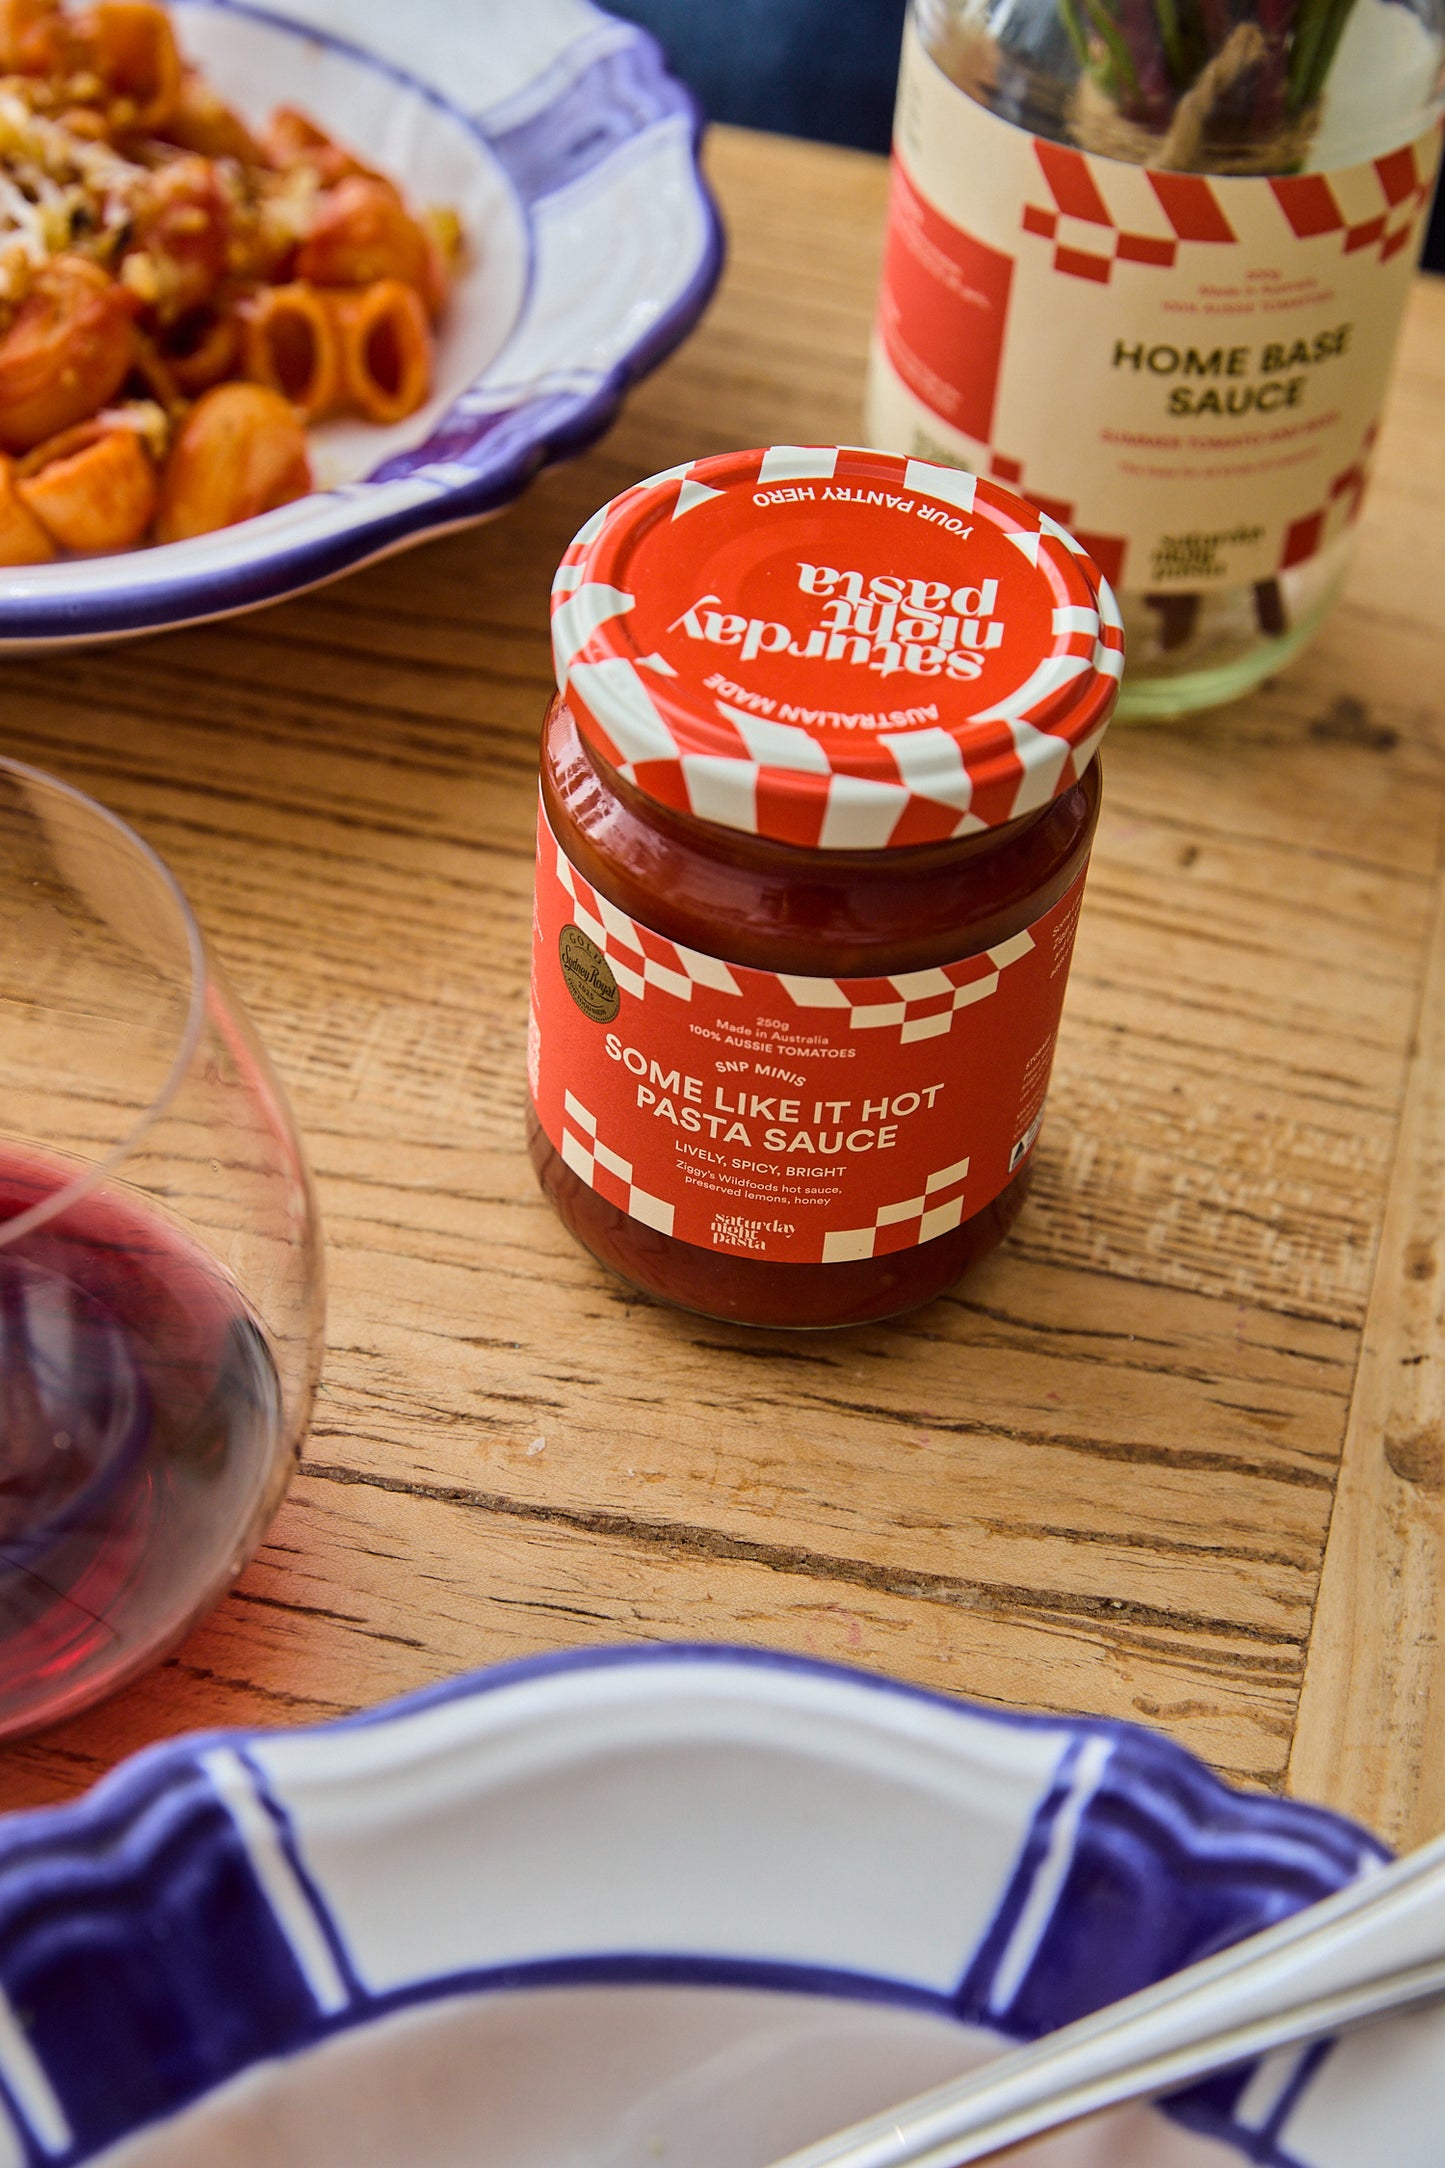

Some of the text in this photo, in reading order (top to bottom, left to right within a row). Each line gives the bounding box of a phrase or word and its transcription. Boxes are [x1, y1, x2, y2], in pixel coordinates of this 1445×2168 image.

[1113, 323, 1353, 377] HOME BASE
[1168, 376, 1306, 418] SAUCE
[752, 487, 974, 540] YOUR PANTRY HERO
[797, 562, 999, 617] pasta
[666, 595, 986, 681] saturday
[820, 594, 1004, 651] night
[703, 673, 939, 730] AUSTRALIAN MADE
[569, 932, 602, 964] GOLD
[562, 945, 590, 981] Sydney
[589, 965, 616, 998] Royal
[689, 1024, 856, 1058] 100% AUSSIE TOMATOES
[716, 1019, 829, 1045] Made in Australia
[756, 1017, 789, 1031] 250g
[604, 1033, 945, 1124] SOME LIKE IT HOT
[715, 1061, 806, 1087] SNP MINIS
[636, 1084, 898, 1154] PASTA SAUCE
[675, 1140, 847, 1178] LIVELY, SPICY, BRIGHT
[676, 1159, 842, 1195] Ziggy's Wildfoods hot sauce,
[685, 1176, 831, 1206] preserved lemons, honey
[710, 1221, 759, 1241] night
[712, 1232, 767, 1250] pasta
[715, 1213, 796, 1239] saturday
